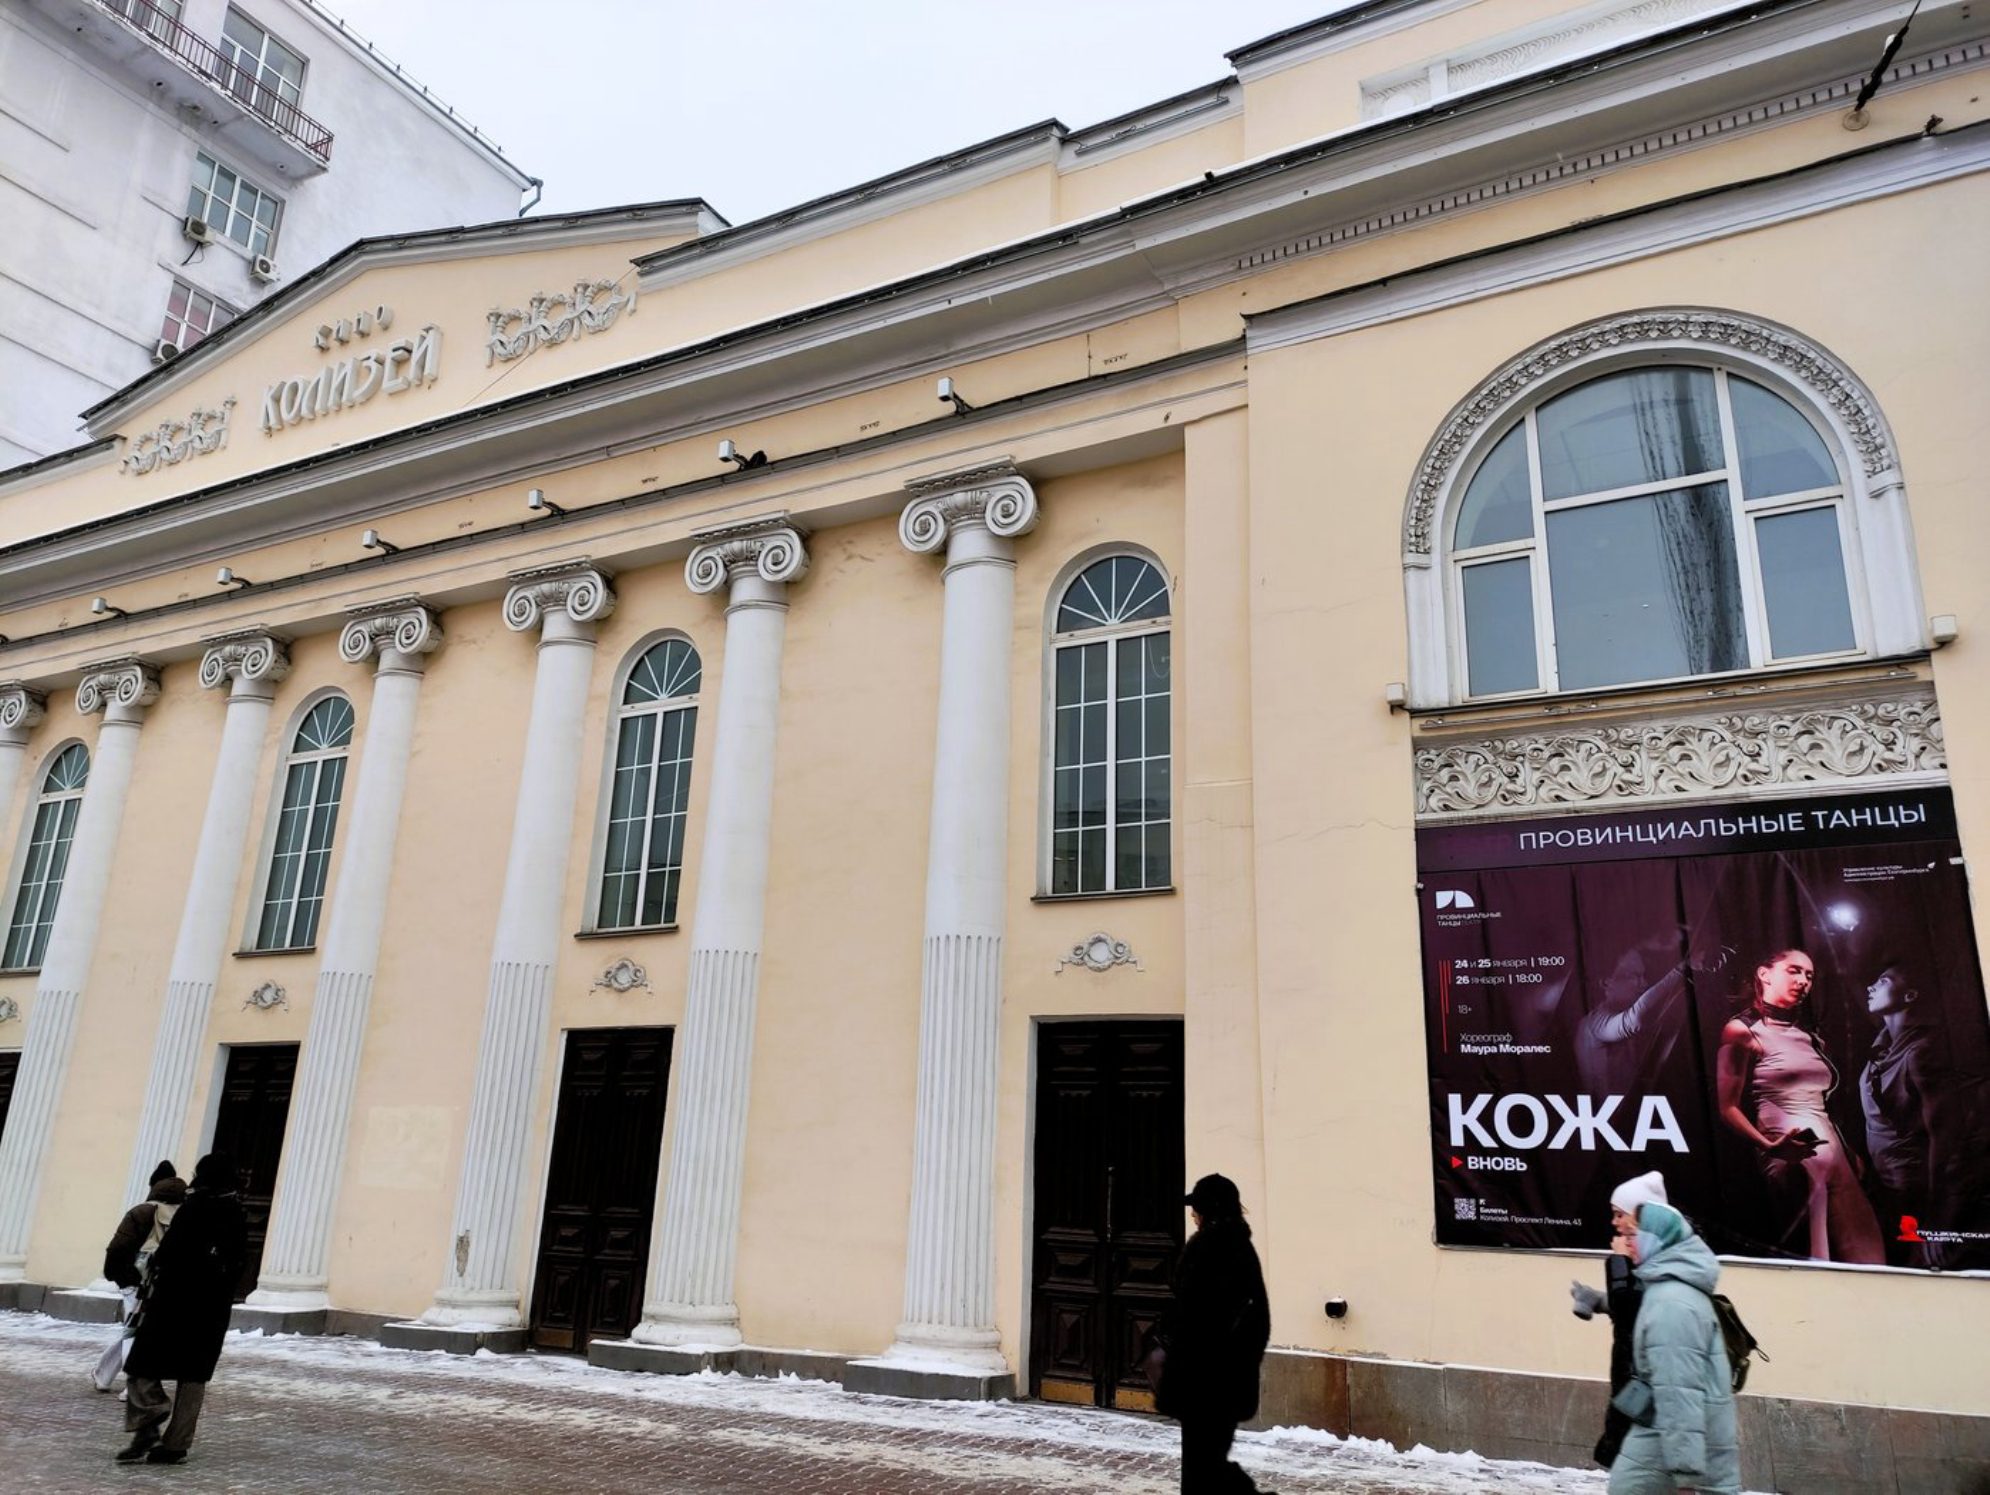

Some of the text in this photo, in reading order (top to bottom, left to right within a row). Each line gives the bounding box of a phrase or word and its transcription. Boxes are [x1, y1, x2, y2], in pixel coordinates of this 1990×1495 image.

[261, 323, 443, 431] КОЛИЗЕЙ
[1519, 802, 1927, 851] ПРОВИНЦИАЛЬНЫЕ ТАНЦЫ
[1455, 959, 1469, 968] 24
[1478, 958, 1492, 968] 25
[1492, 959, 1528, 969] января
[1537, 956, 1565, 966] 19:00
[1456, 973, 1542, 986] 26 января 18:00
[1457, 1004, 1473, 1014] 18+
[1460, 1033, 1512, 1044] Хореограф
[1461, 1044, 1551, 1056] Маура Моралес
[1448, 1093, 1690, 1153] КОЖА
[1467, 1156, 1528, 1171] ВНОВЬ
[1479, 1207, 1508, 1215] Билеты
